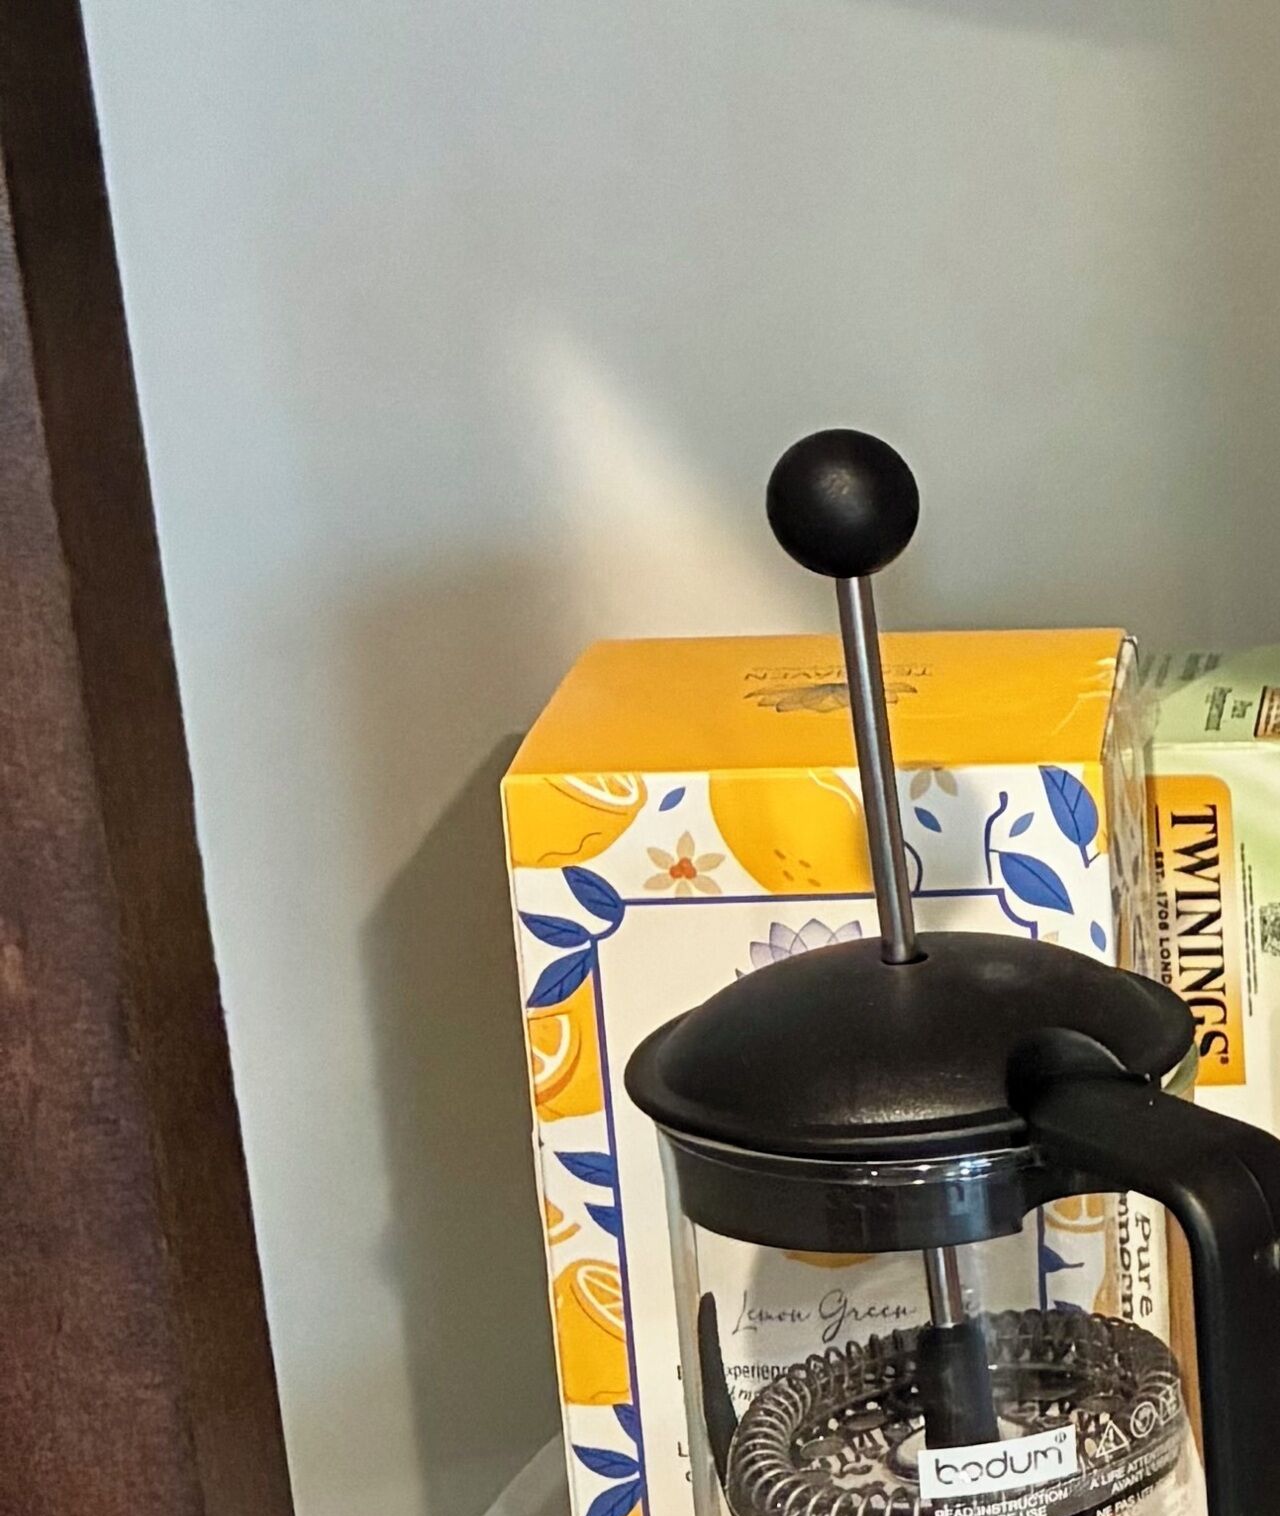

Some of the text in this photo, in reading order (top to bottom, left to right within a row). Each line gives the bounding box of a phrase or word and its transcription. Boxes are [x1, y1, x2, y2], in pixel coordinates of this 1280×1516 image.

[1156, 891, 1169, 930] 1706
[1171, 804, 1229, 1057] TWININGS
[1159, 937, 1174, 986] LOND
[731, 1287, 917, 1343] Lemon Green
